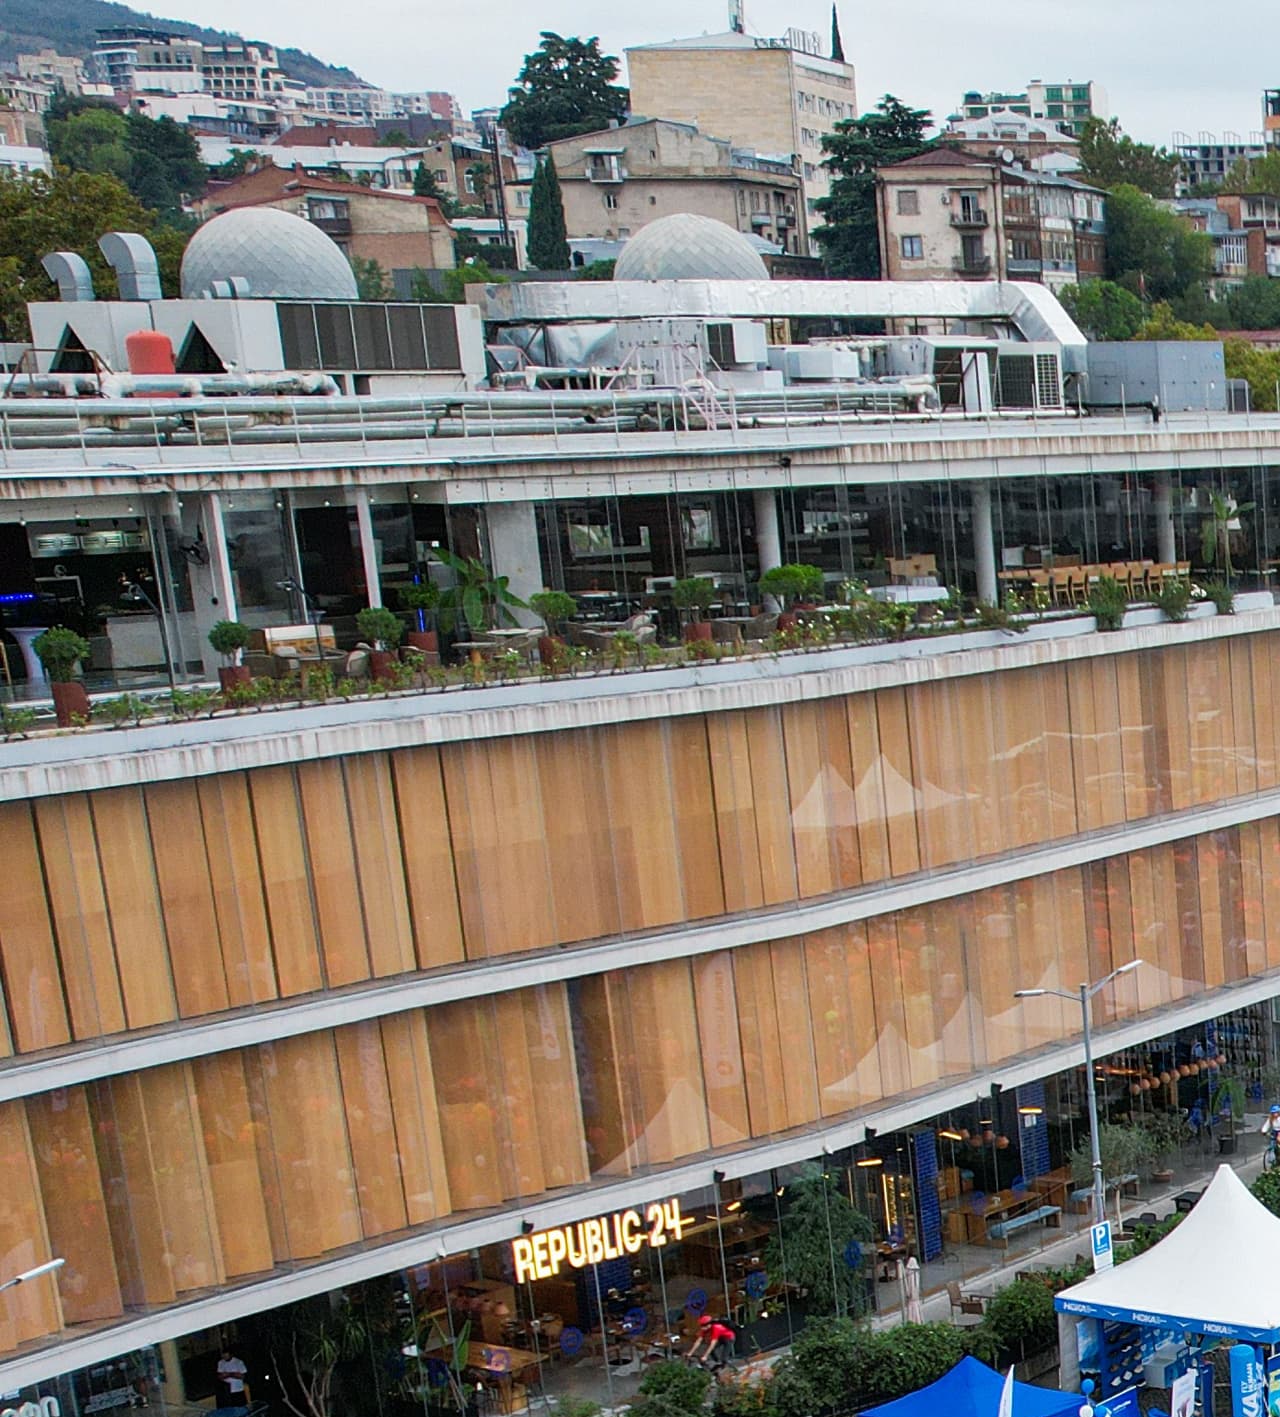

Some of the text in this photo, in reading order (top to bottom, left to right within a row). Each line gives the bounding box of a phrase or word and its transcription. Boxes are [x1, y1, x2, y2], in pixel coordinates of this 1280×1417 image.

[512, 1198, 694, 1284] REPUBLIC 24
[1095, 1226, 1106, 1246] P
